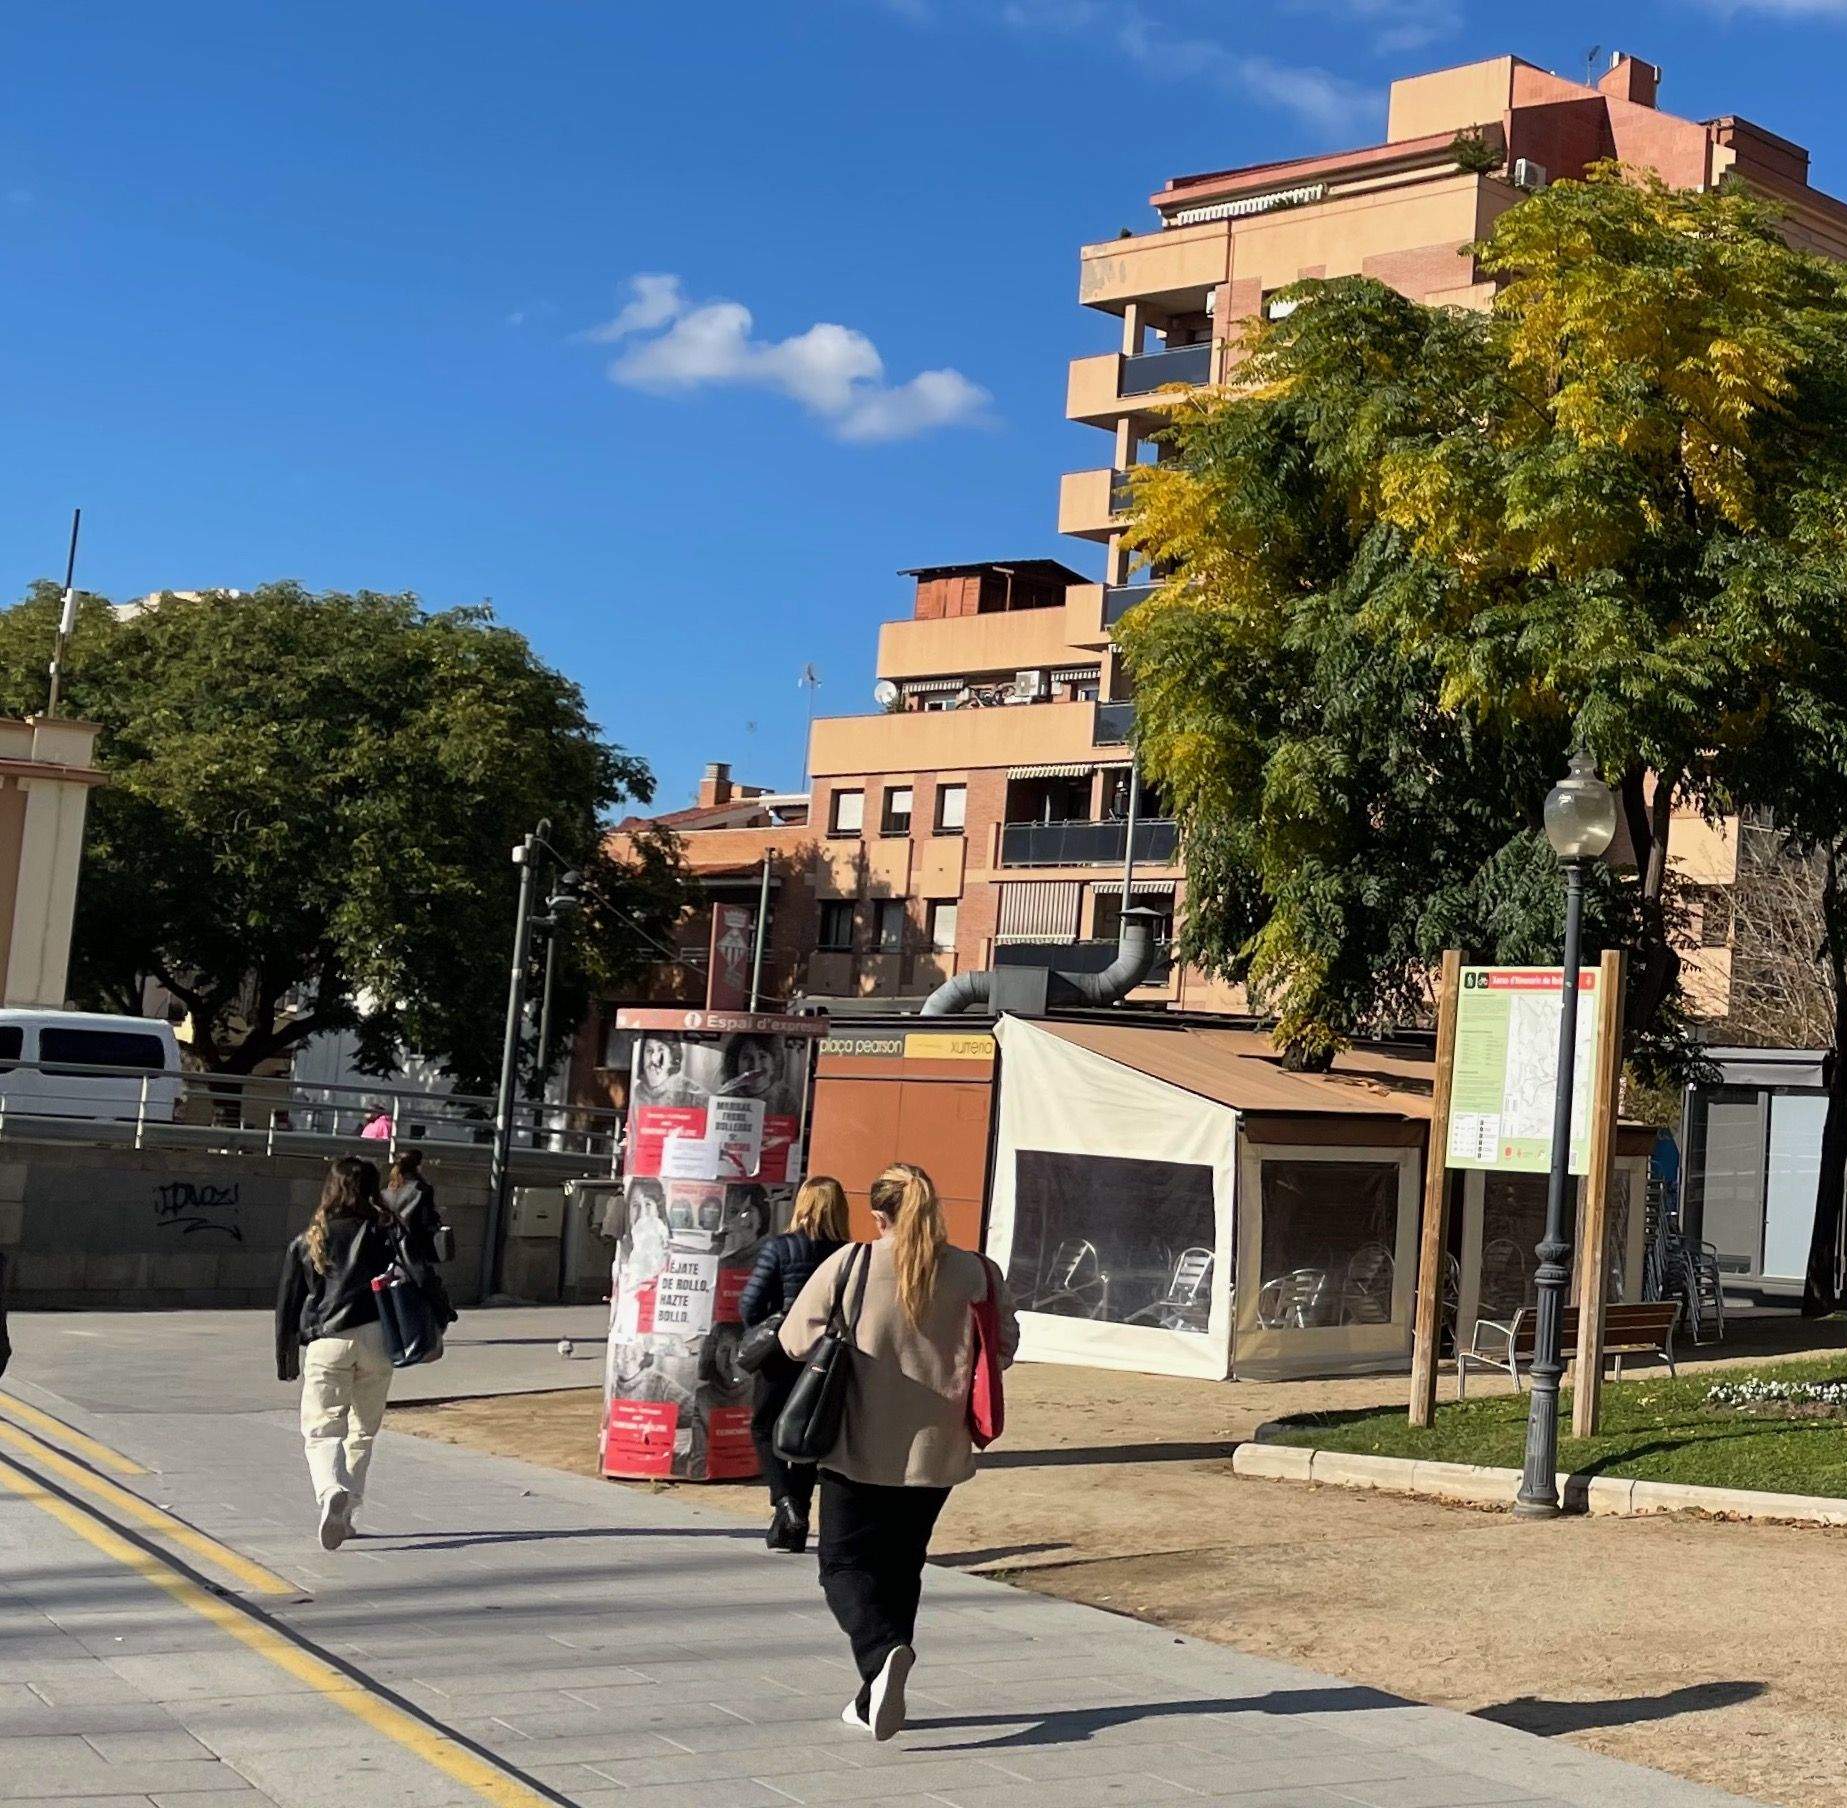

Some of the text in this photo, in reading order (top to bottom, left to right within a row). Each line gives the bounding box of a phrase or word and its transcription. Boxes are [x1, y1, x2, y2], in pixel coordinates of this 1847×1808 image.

[706, 1014, 749, 1031] Espai
[819, 1036, 853, 1056] plaça
[855, 1039, 902, 1056] pearson
[662, 1278, 673, 1289] DE
[676, 1278, 710, 1293] ROLLO,
[659, 1294, 689, 1307] HAZTE
[658, 1310, 690, 1323] BOLLO.
